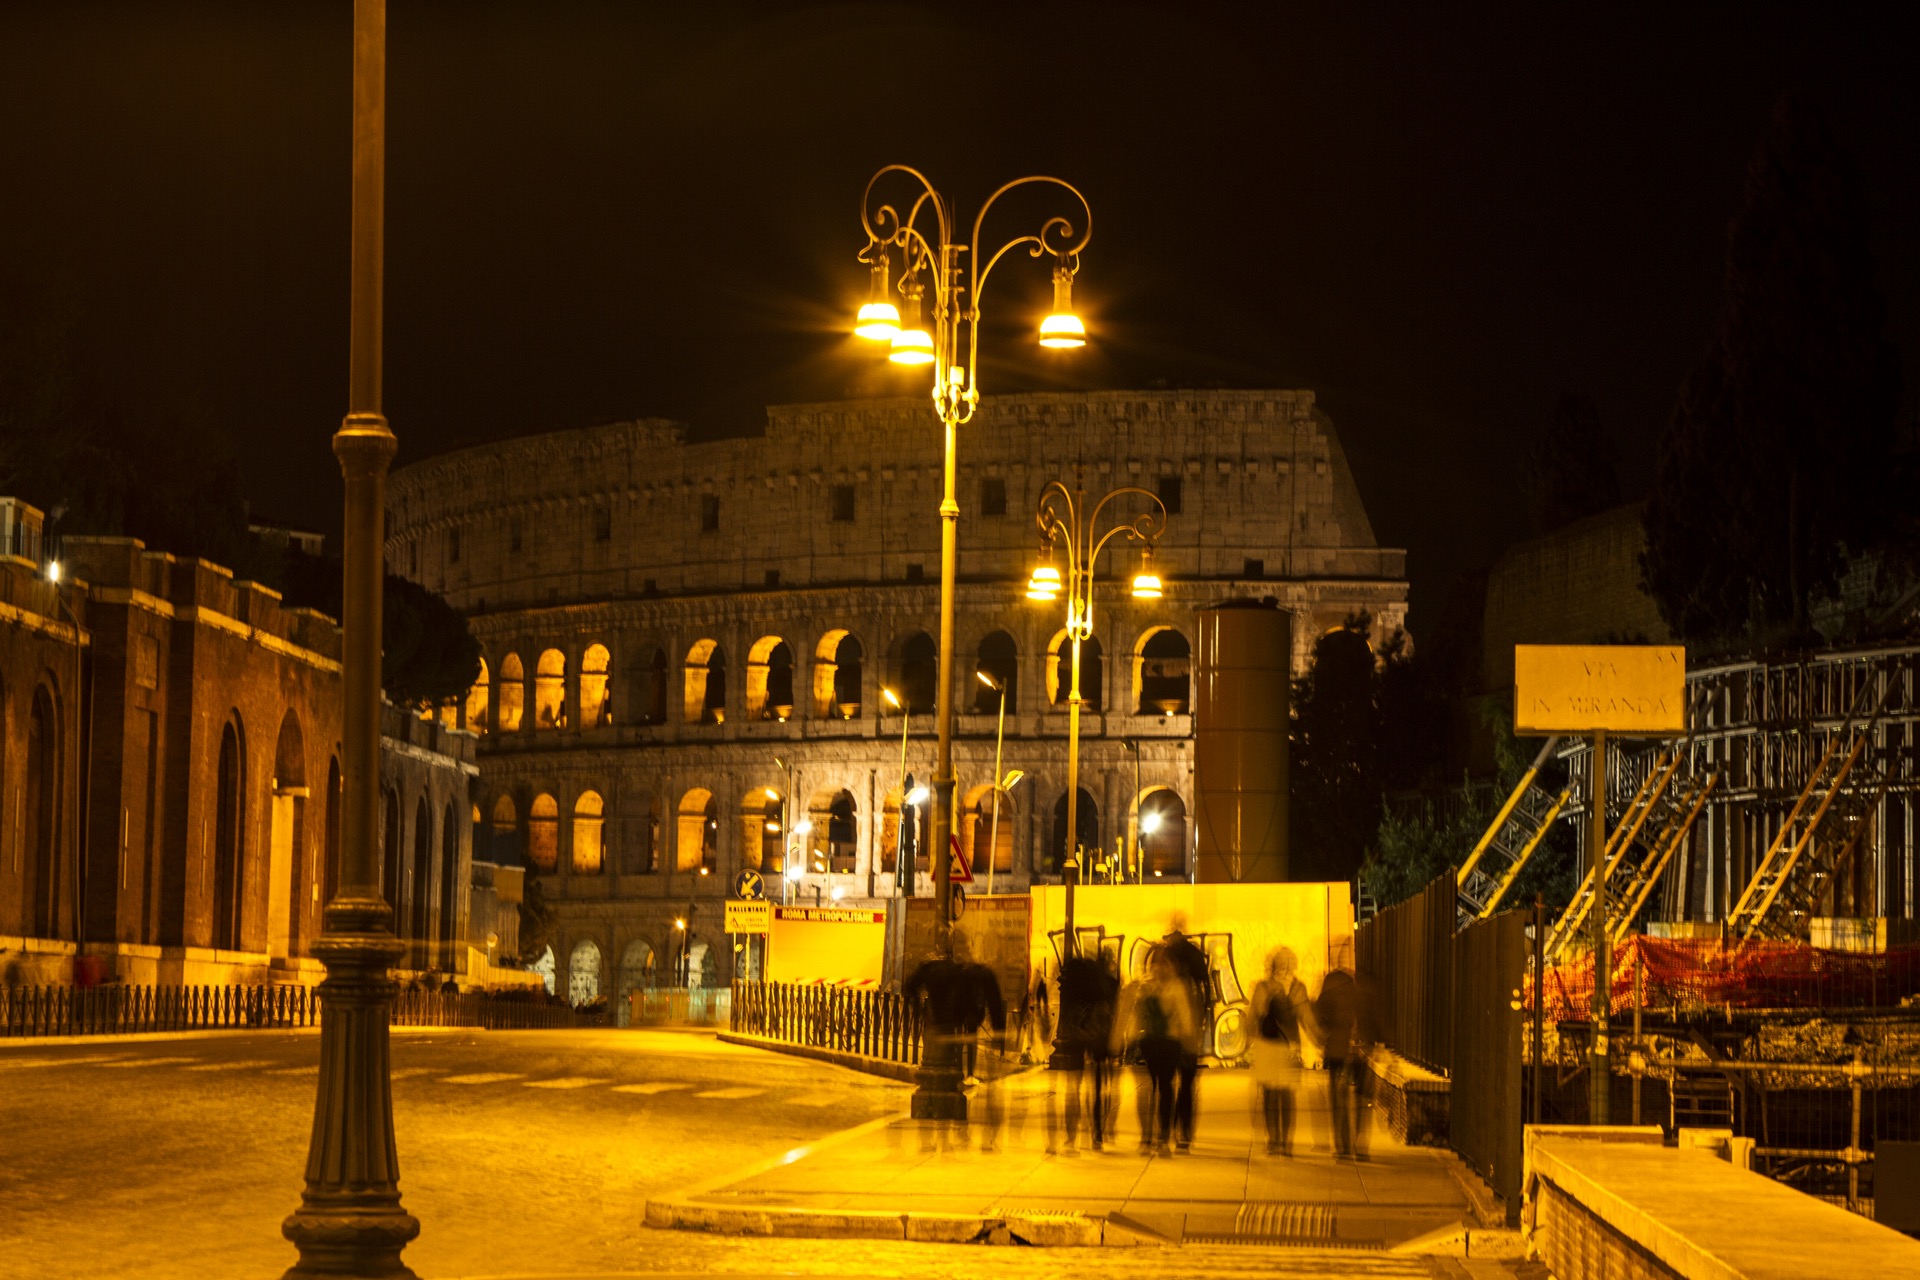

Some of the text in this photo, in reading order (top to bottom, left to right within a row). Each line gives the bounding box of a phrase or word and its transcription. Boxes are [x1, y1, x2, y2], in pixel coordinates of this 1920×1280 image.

[1582, 660, 1617, 677] VIA
[1532, 696, 1668, 714] IN MIRANDA
[781, 909, 874, 923] ROMA METROPOLITANE
